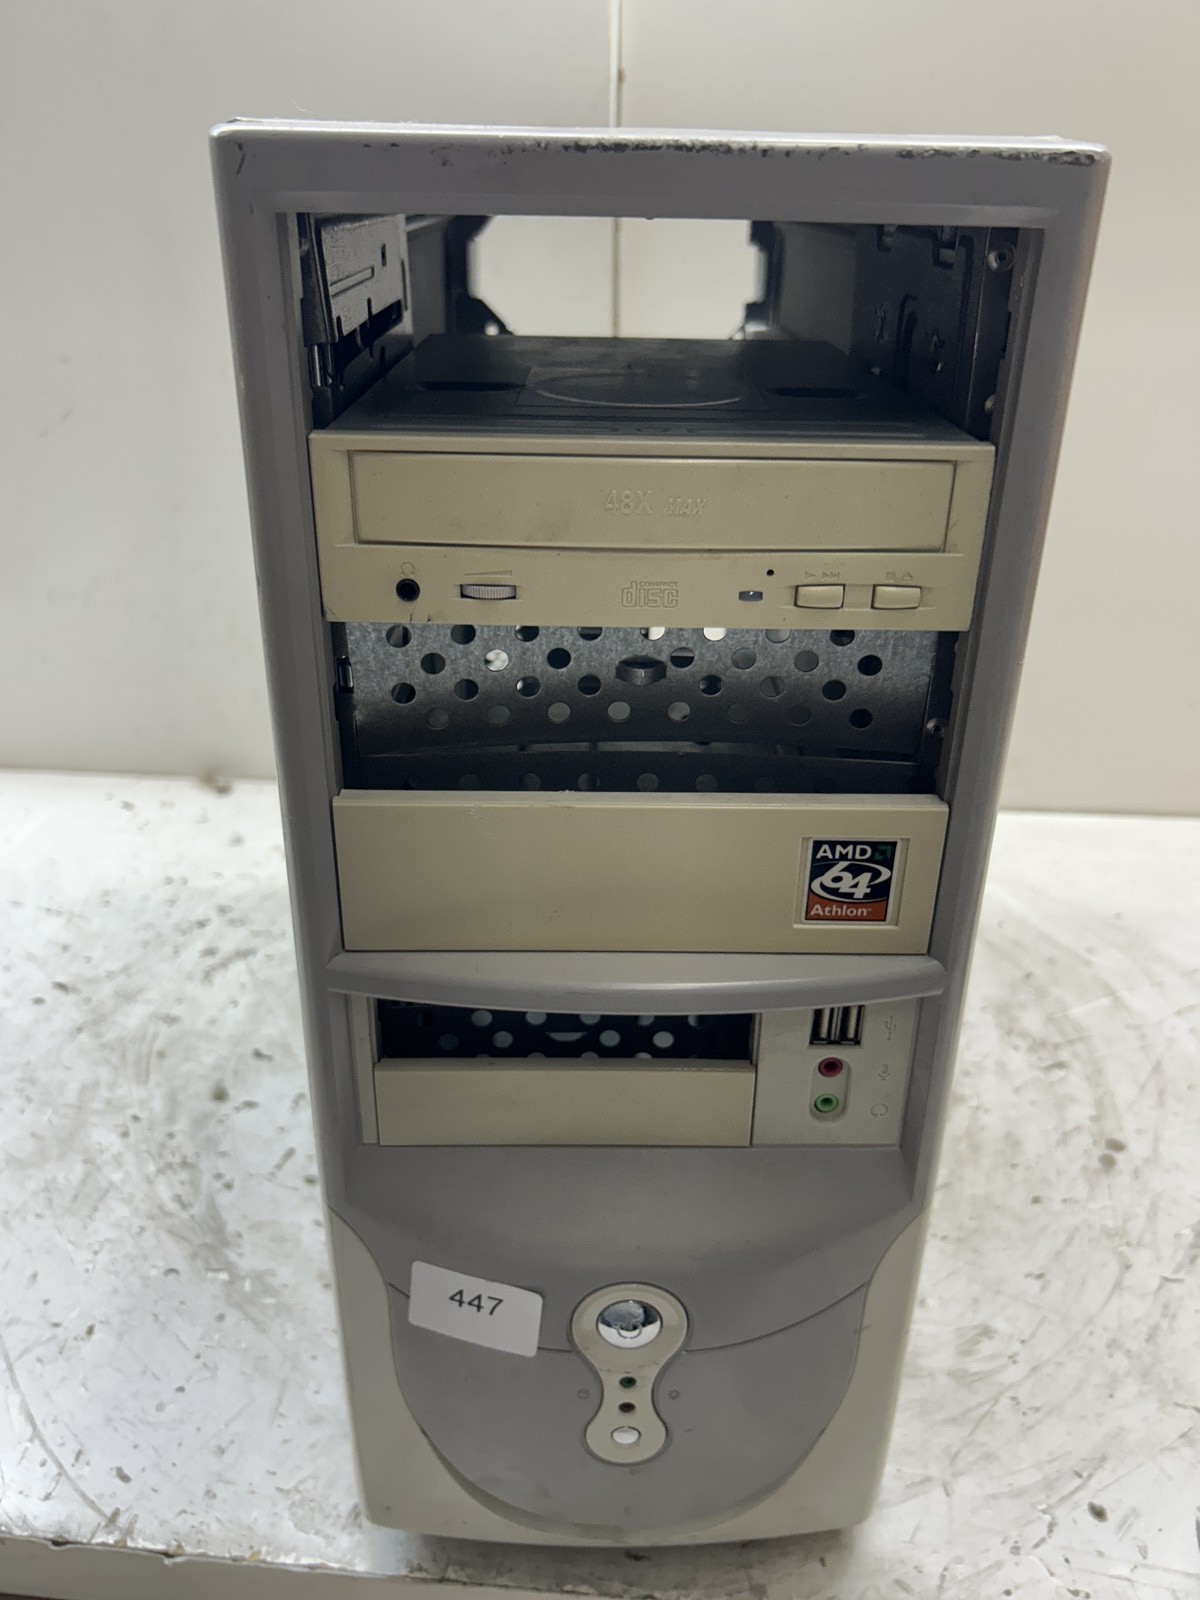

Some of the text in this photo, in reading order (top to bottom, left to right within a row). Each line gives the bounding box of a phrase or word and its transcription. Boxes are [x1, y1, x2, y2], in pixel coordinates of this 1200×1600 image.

[603, 490, 653, 515] 48X
[621, 581, 679, 608] disc
[815, 844, 872, 860] AMD
[820, 861, 873, 899] 64
[448, 1289, 504, 1316] 447
